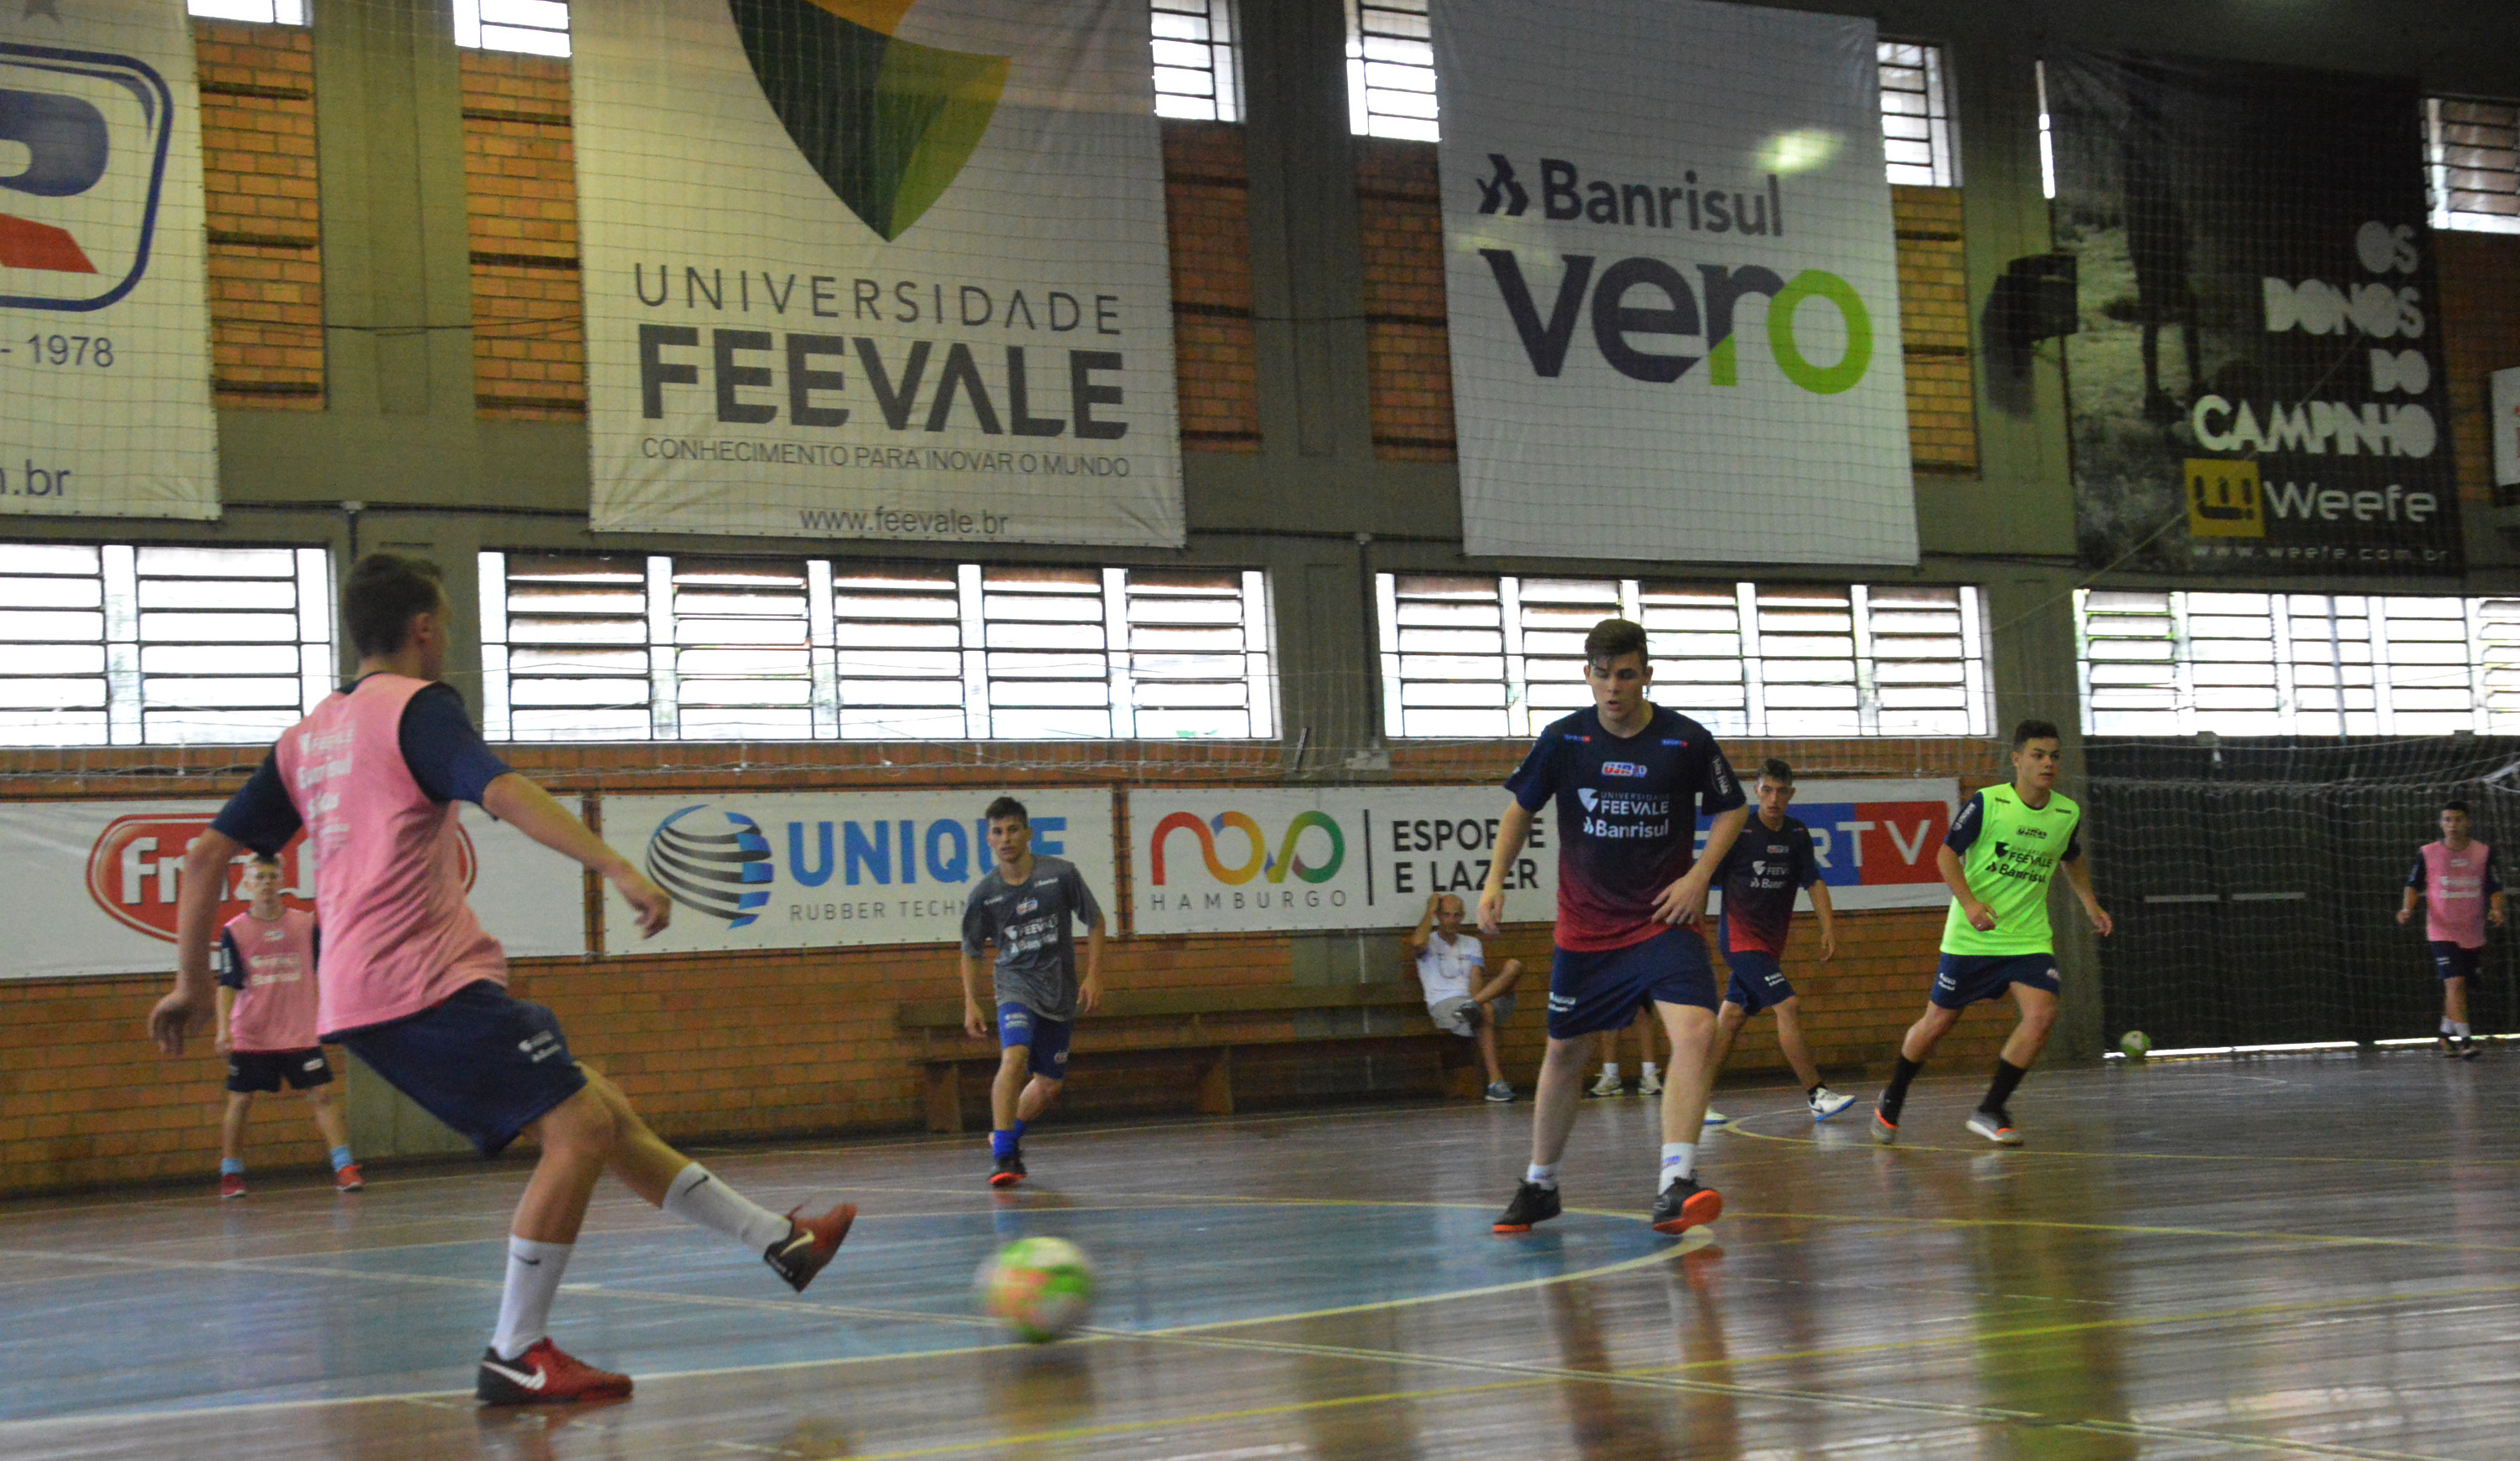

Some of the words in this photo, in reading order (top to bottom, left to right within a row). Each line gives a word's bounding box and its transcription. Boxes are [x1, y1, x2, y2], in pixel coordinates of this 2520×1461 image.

[1540, 157, 1784, 236] Banrisul
[635, 262, 1123, 334] UNIVERSIDADE
[28, 334, 114, 368] 1978
[638, 323, 1129, 440] FEEVALE
[2193, 395, 2436, 458] CAMPINHO
[641, 437, 849, 467] CONHECIMENTO
[855, 447, 920, 468] PARA
[925, 450, 1012, 472] INOVAR
[1019, 453, 1039, 473] O
[1043, 454, 1131, 477] MUNDO
[0, 459, 71, 496] .br
[2264, 481, 2438, 522] Weefe
[799, 506, 1009, 534] www.feevale.br
[1601, 800, 1669, 816] FEEVALE
[1595, 818, 1670, 839] Banrisul
[1395, 862, 1414, 893] E
[790, 902, 886, 922] RUBBER
[1152, 890, 1347, 911] HAMBURGO
